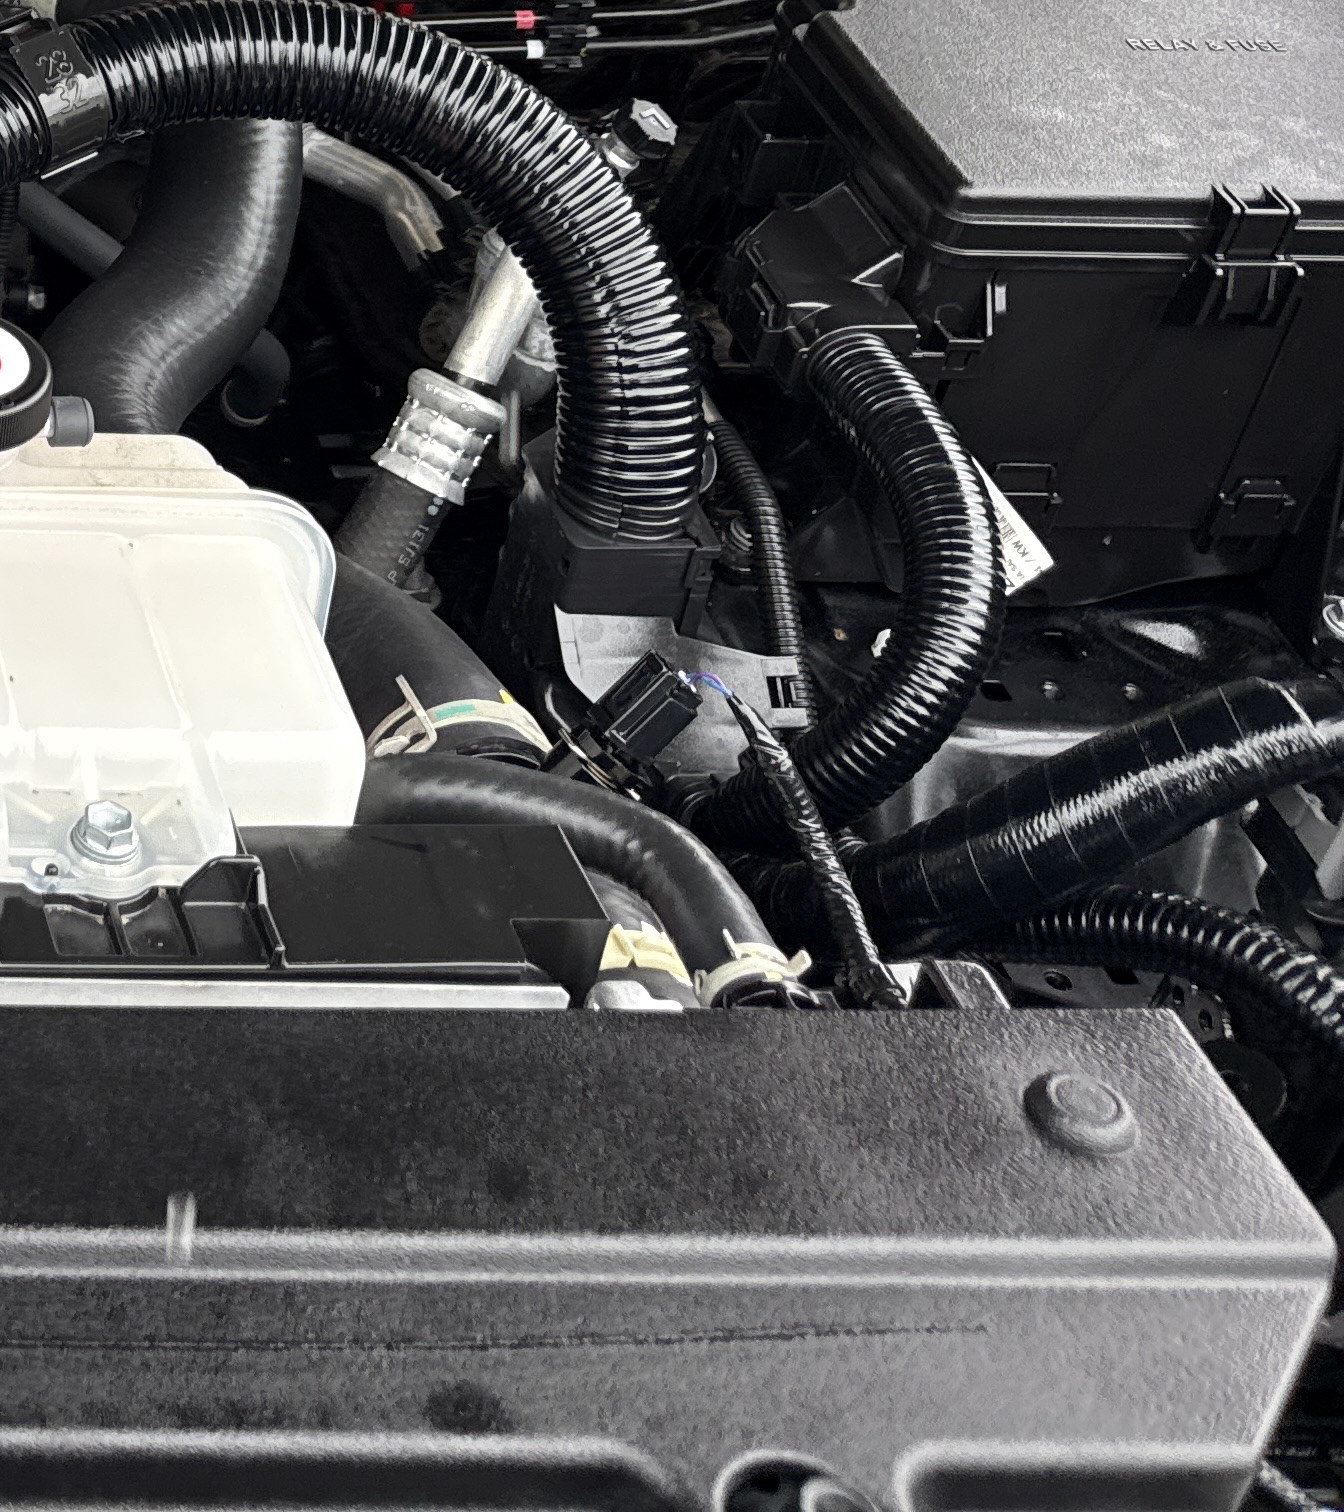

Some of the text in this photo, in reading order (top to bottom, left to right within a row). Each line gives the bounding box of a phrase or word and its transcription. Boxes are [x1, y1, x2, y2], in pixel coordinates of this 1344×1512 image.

[1125, 38, 1288, 53] RELAY & FUSE
